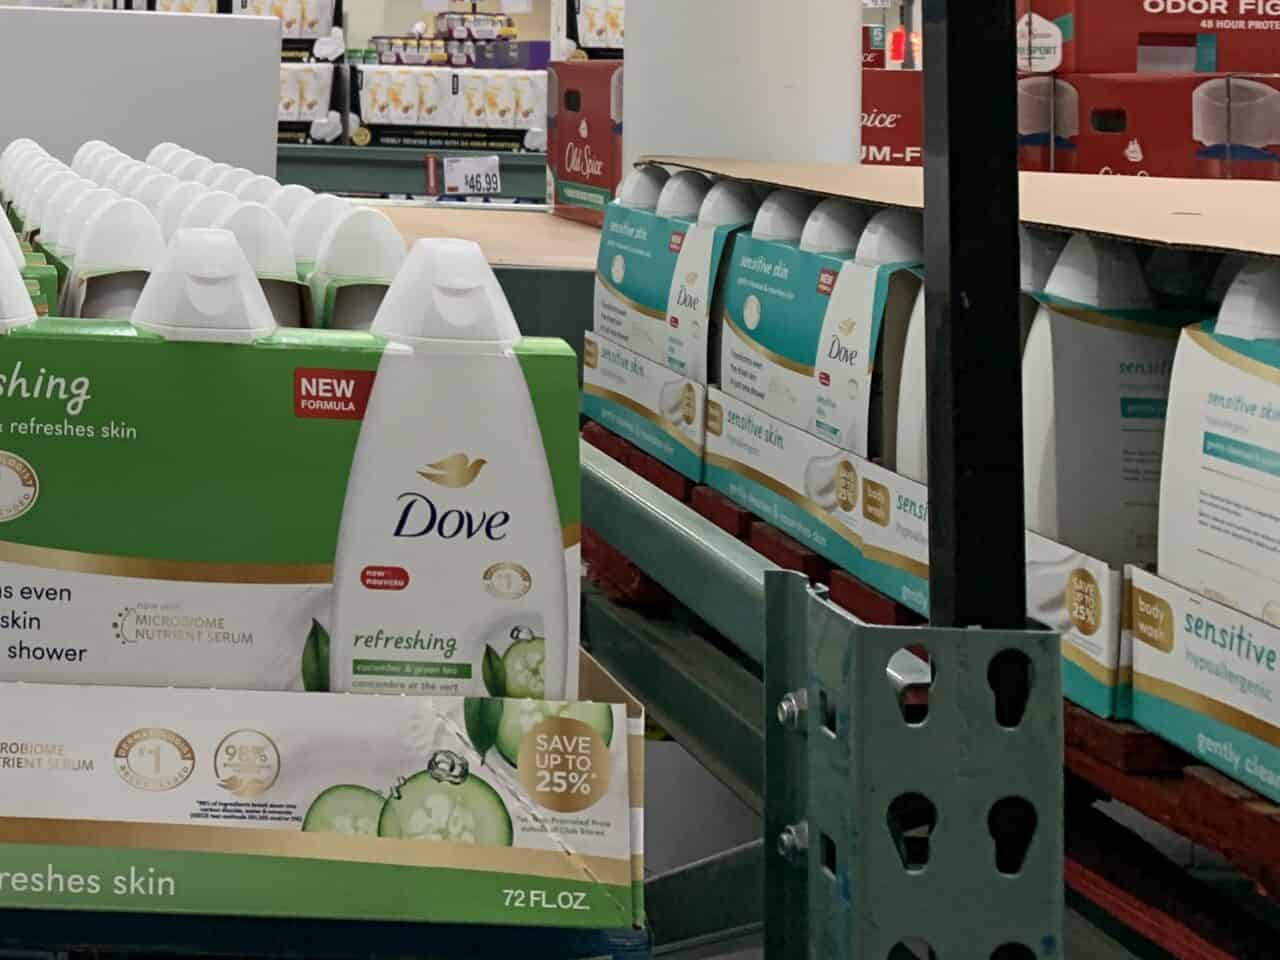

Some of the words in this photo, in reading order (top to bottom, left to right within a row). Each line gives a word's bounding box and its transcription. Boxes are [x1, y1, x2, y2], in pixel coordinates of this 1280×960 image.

[1200, 20, 1214, 29] 48
[1216, 20, 1245, 29] HOUR
[565, 142, 585, 174] Old
[583, 146, 603, 178] Spice
[464, 172, 499, 193] $46.99
[677, 285, 699, 311] Dove
[828, 334, 858, 367] Dove
[301, 377, 355, 397] NEW
[301, 400, 355, 411] FORMULA
[9, 418, 95, 438] refreshes
[101, 422, 137, 440] skin
[727, 409, 763, 439] sensitive
[764, 424, 785, 449] skin
[392, 492, 510, 541] Dove
[20, 584, 72, 602] even
[1072, 577, 1096, 597] SAVE
[1072, 591, 1084, 605] UP
[1085, 595, 1096, 609] TO
[1137, 595, 1165, 621] body
[0, 610, 41, 631] skin
[1138, 623, 1164, 639] wash
[208, 632, 254, 645] SERUM
[353, 629, 457, 659] refreshing
[1183, 612, 1277, 672] sensitive
[7, 640, 87, 663] shower
[536, 735, 592, 754] SAVE
[1197, 732, 1242, 769] gently
[535, 754, 561, 769] UP
[564, 754, 591, 771] TO
[113, 861, 176, 896] skin
[504, 890, 525, 907] 72
